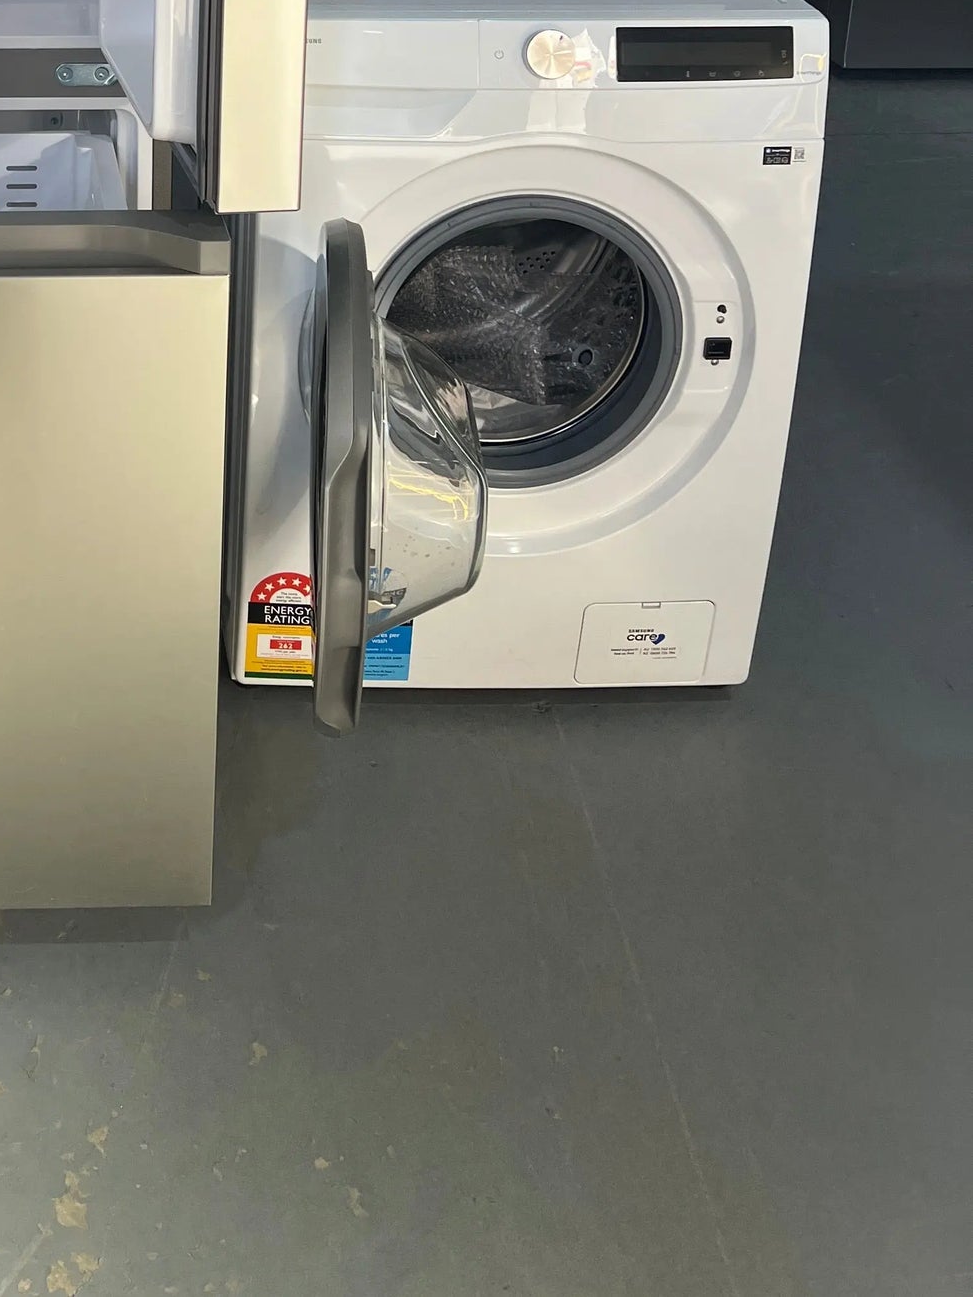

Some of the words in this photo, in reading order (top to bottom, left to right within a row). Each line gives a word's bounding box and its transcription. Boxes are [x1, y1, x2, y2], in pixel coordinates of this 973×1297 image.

[264, 605, 312, 616] ENERGY
[264, 615, 310, 625] RATING
[627, 633, 658, 642] care
